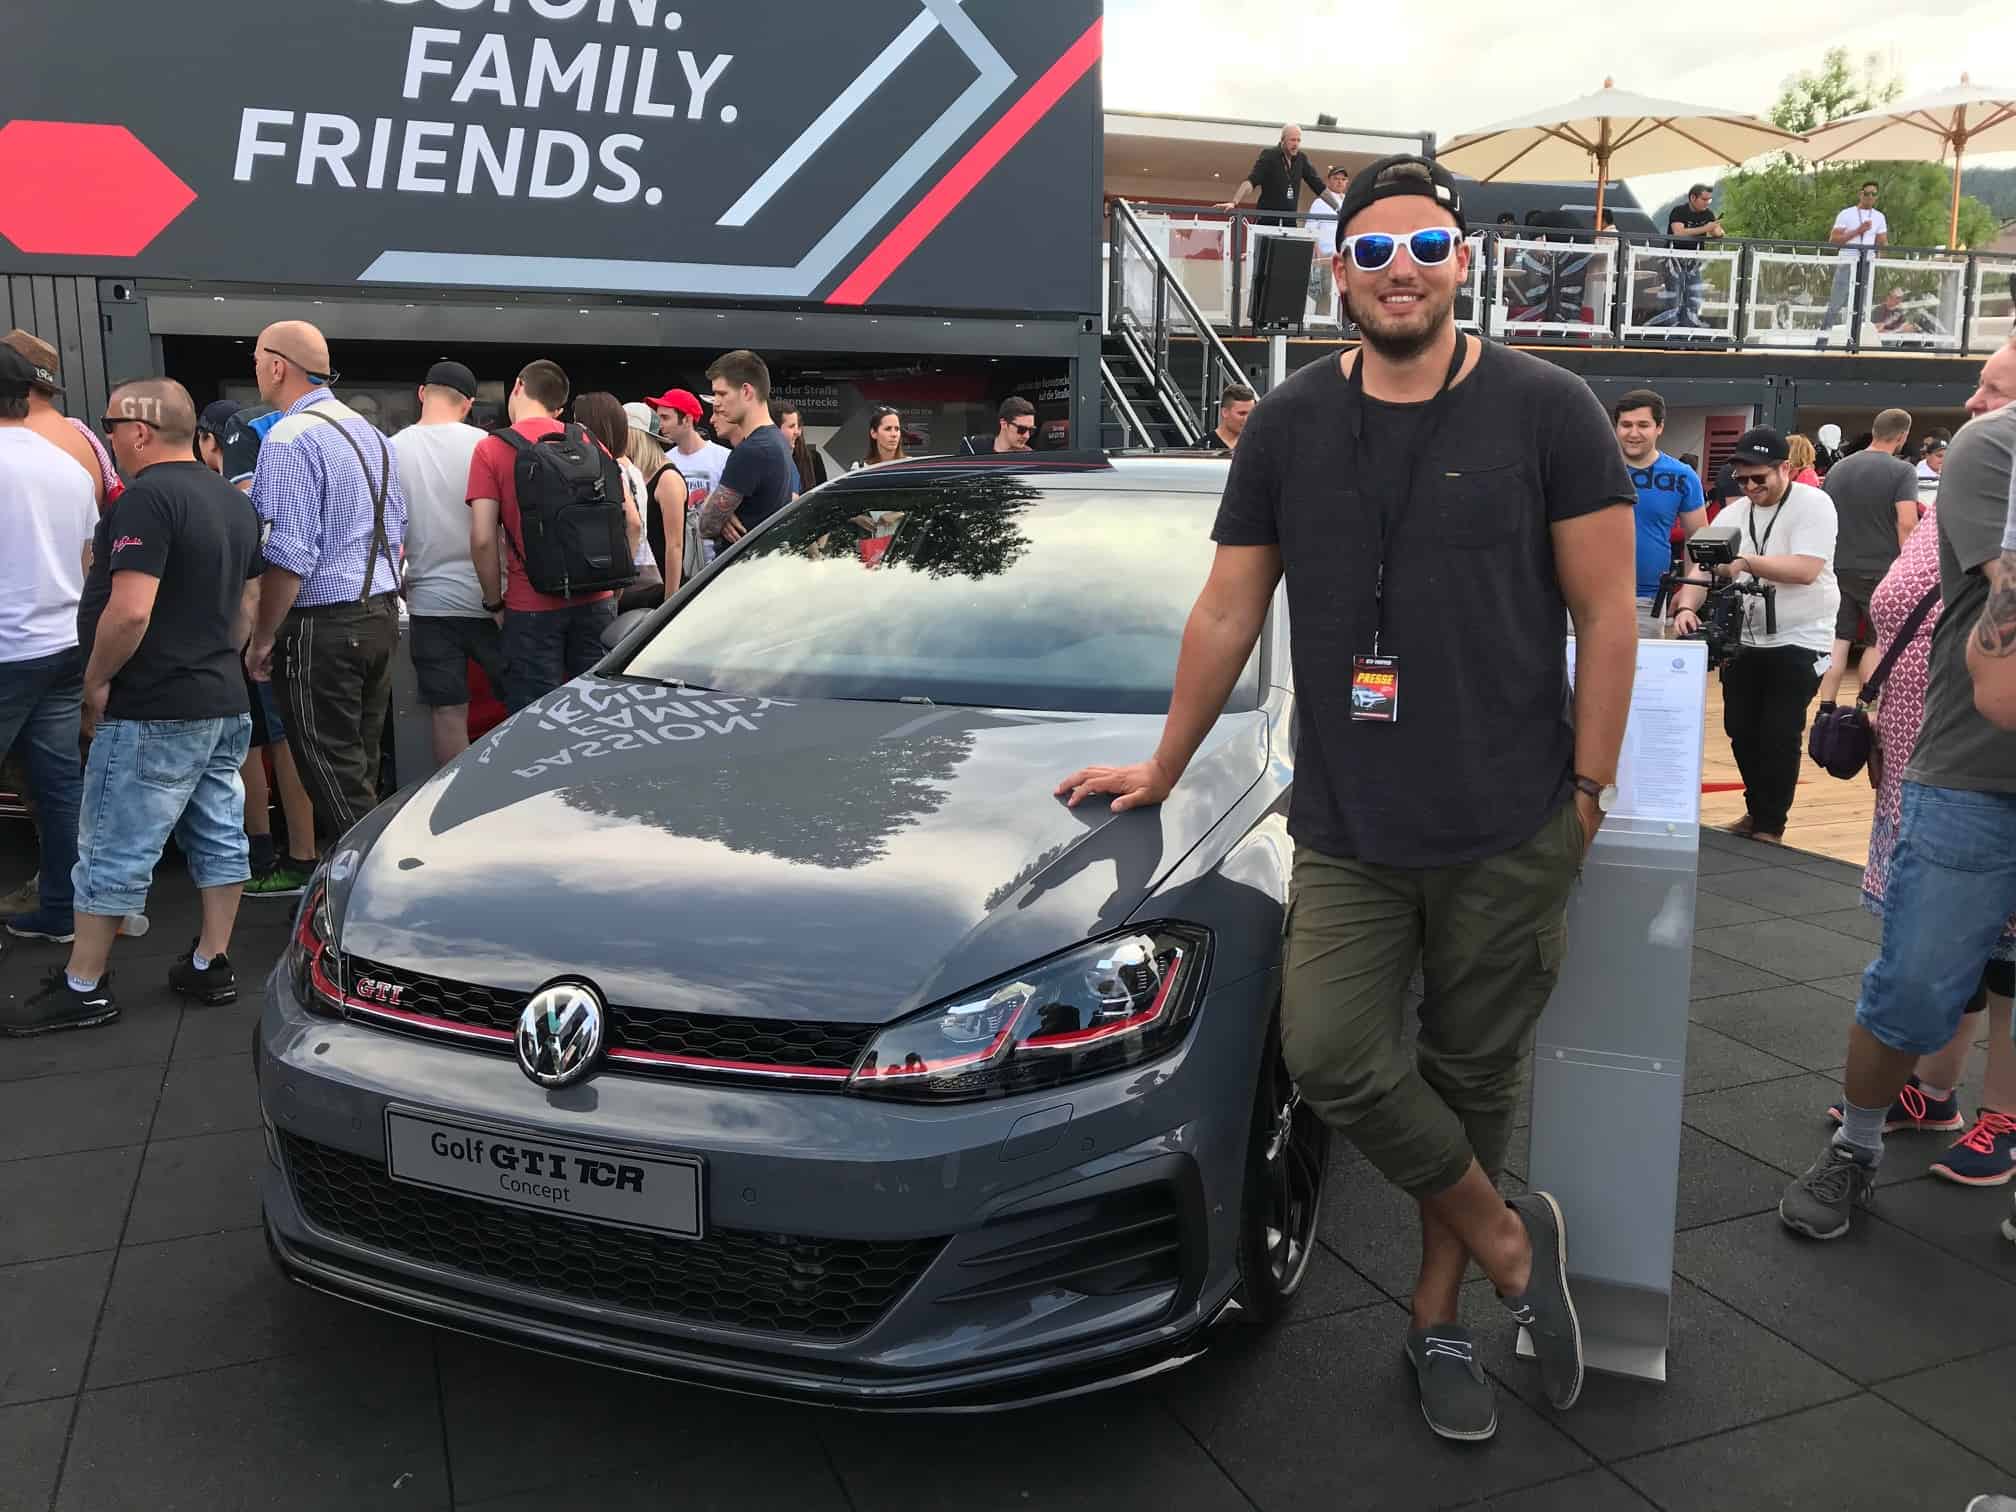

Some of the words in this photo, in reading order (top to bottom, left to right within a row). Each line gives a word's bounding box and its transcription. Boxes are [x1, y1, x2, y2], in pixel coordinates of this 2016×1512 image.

[402, 26, 738, 123] FAMILY.
[233, 107, 663, 206] FRIENDS.
[120, 397, 162, 423] GTI
[1631, 464, 1690, 497] das
[356, 977, 404, 1006] GTI
[431, 1132, 484, 1164] Golf
[490, 1144, 567, 1180] GTI
[574, 1157, 645, 1193] TCR
[499, 1173, 571, 1203] Concept
